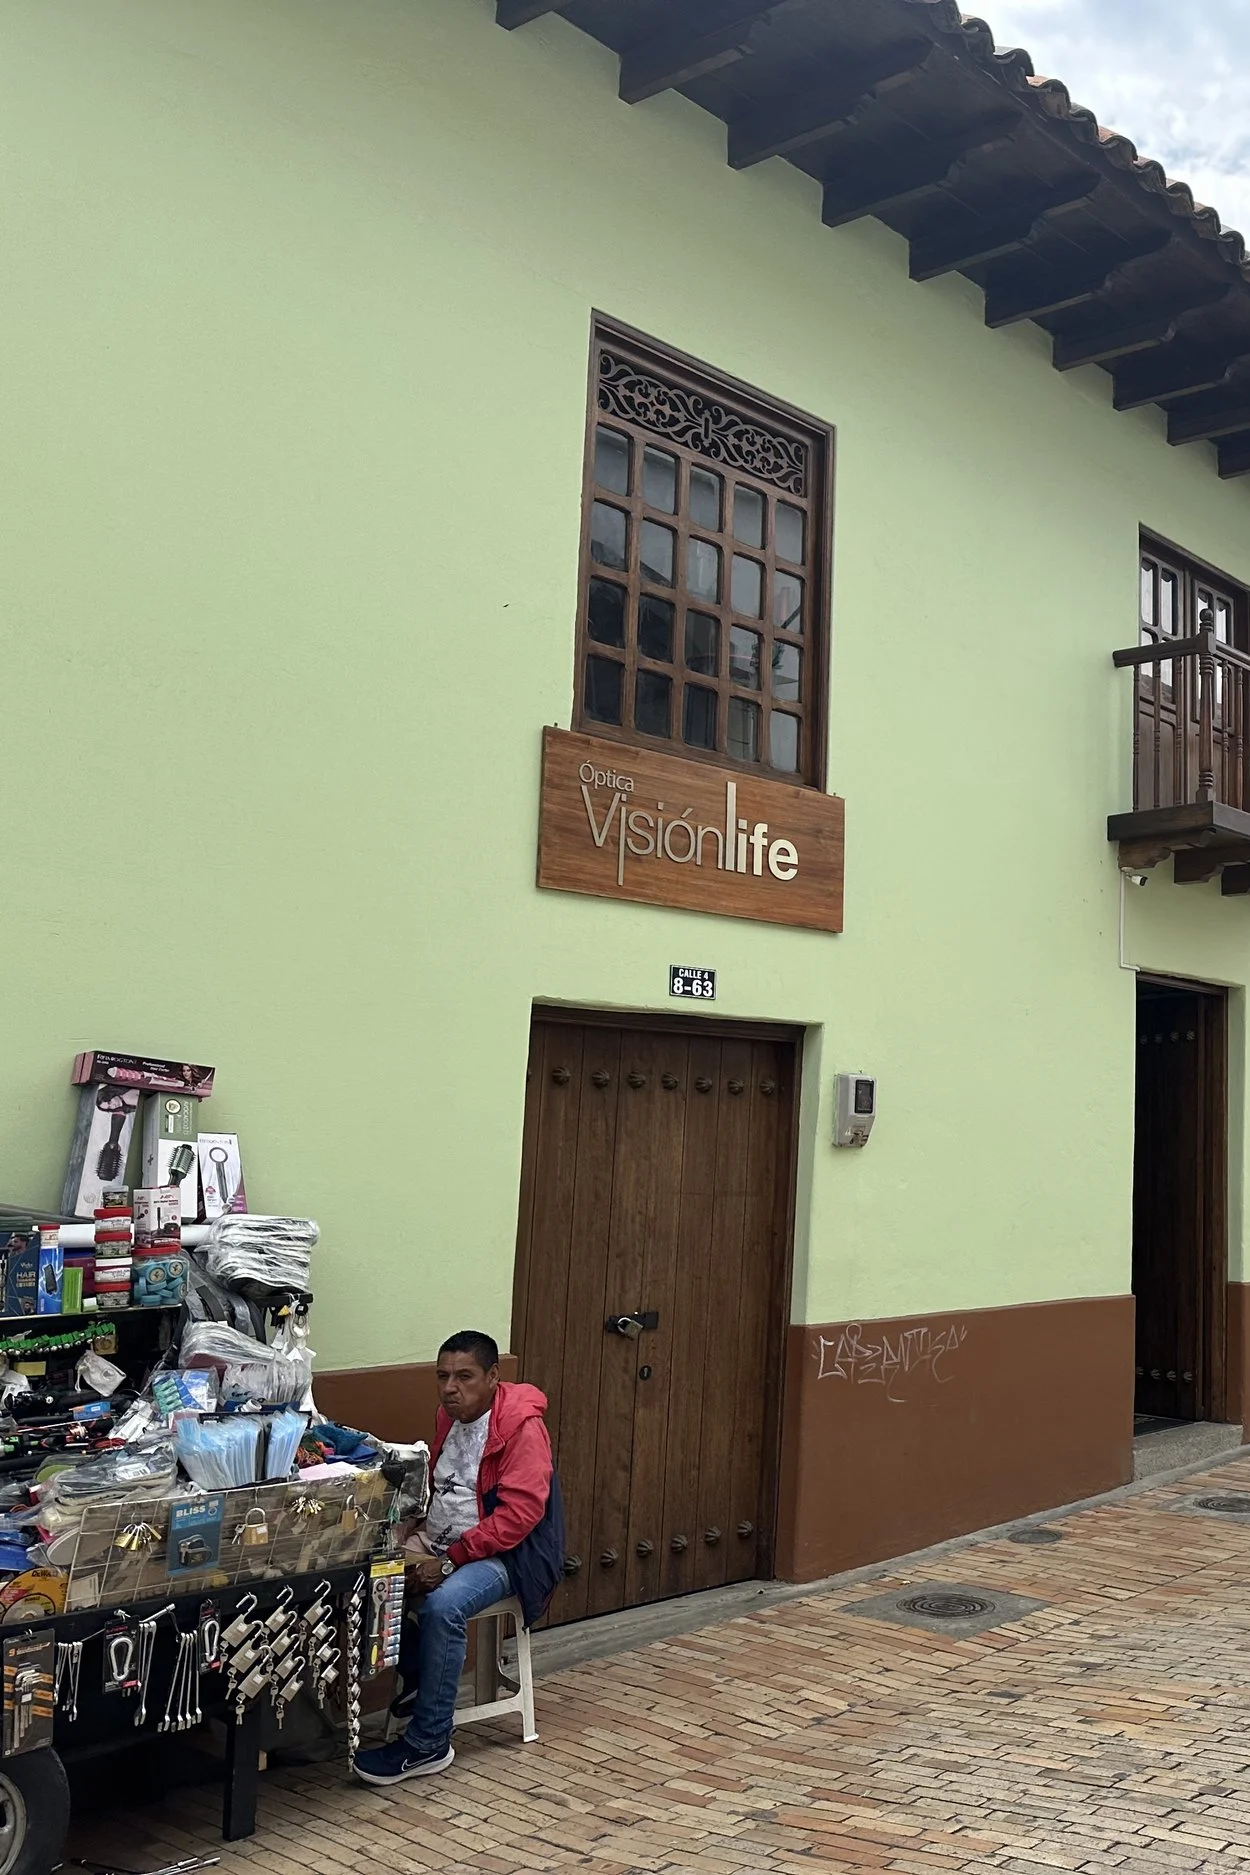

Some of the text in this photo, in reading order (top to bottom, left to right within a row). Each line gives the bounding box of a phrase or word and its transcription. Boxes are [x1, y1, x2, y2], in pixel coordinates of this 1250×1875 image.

[578, 759, 635, 793] Óptica
[678, 968, 709, 980] CALLE 4
[673, 977, 713, 997] 8-63
[176, 1505, 206, 1518] BLISS
